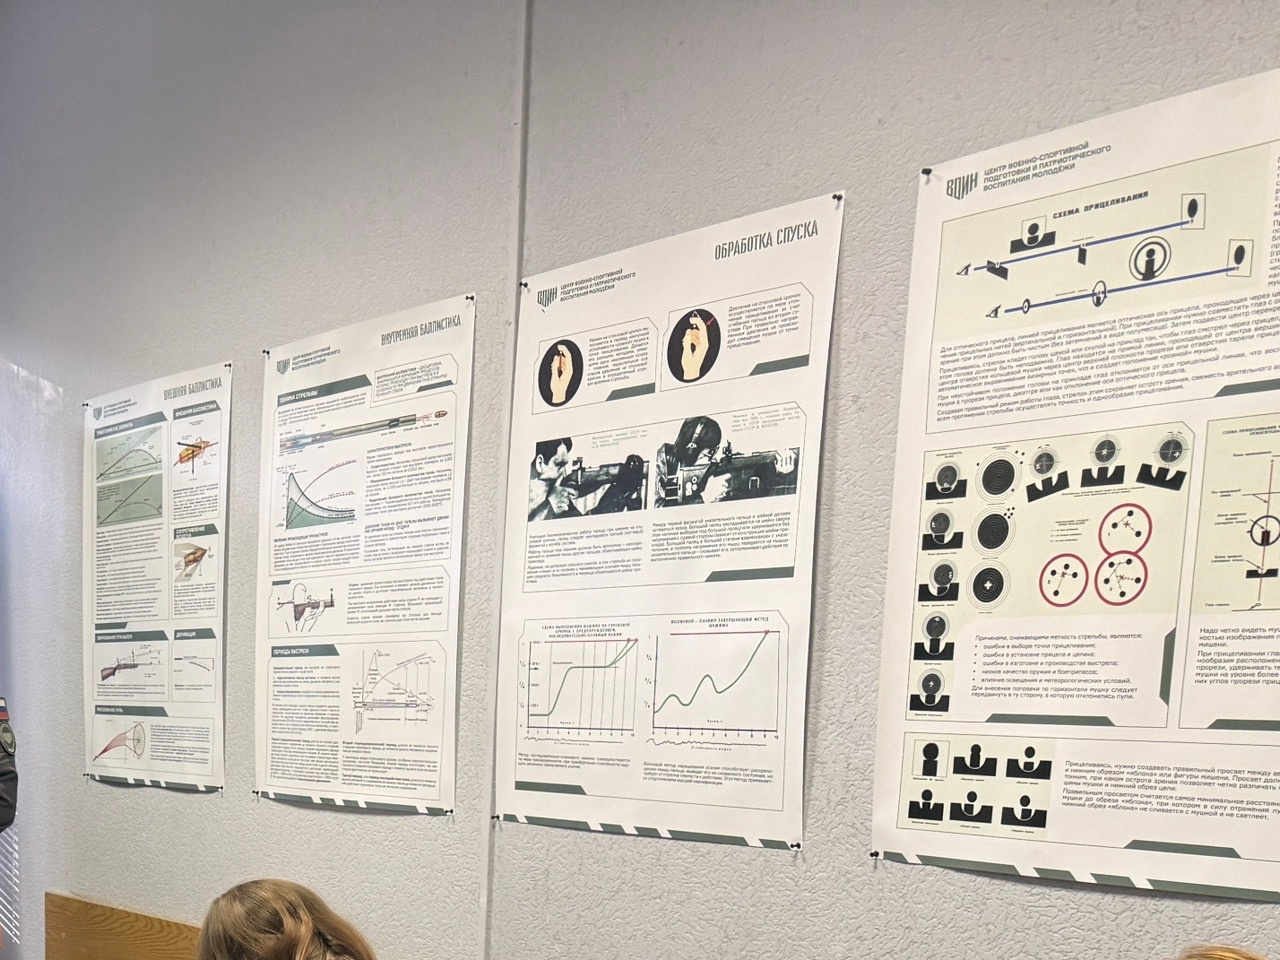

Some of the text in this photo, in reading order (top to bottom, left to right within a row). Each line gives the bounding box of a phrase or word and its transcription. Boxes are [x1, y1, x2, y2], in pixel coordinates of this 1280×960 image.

[983, 169, 1031, 184] ПОДГОТОВКИ
[1039, 145, 1112, 170] ПАТРИОТИЧЕСКОГО
[984, 141, 1089, 176] ЦЕНТР ВОЕННО-СПОРТИВНОЙ
[946, 172, 979, 200] ВОИН
[983, 175, 1031, 191] ВОСПИТАНИЯ
[1053, 191, 1149, 219] СХЕМА ПРИЦЕЛИВАНИЯ
[714, 220, 818, 260] ОБРАБОТКА СПУСКА
